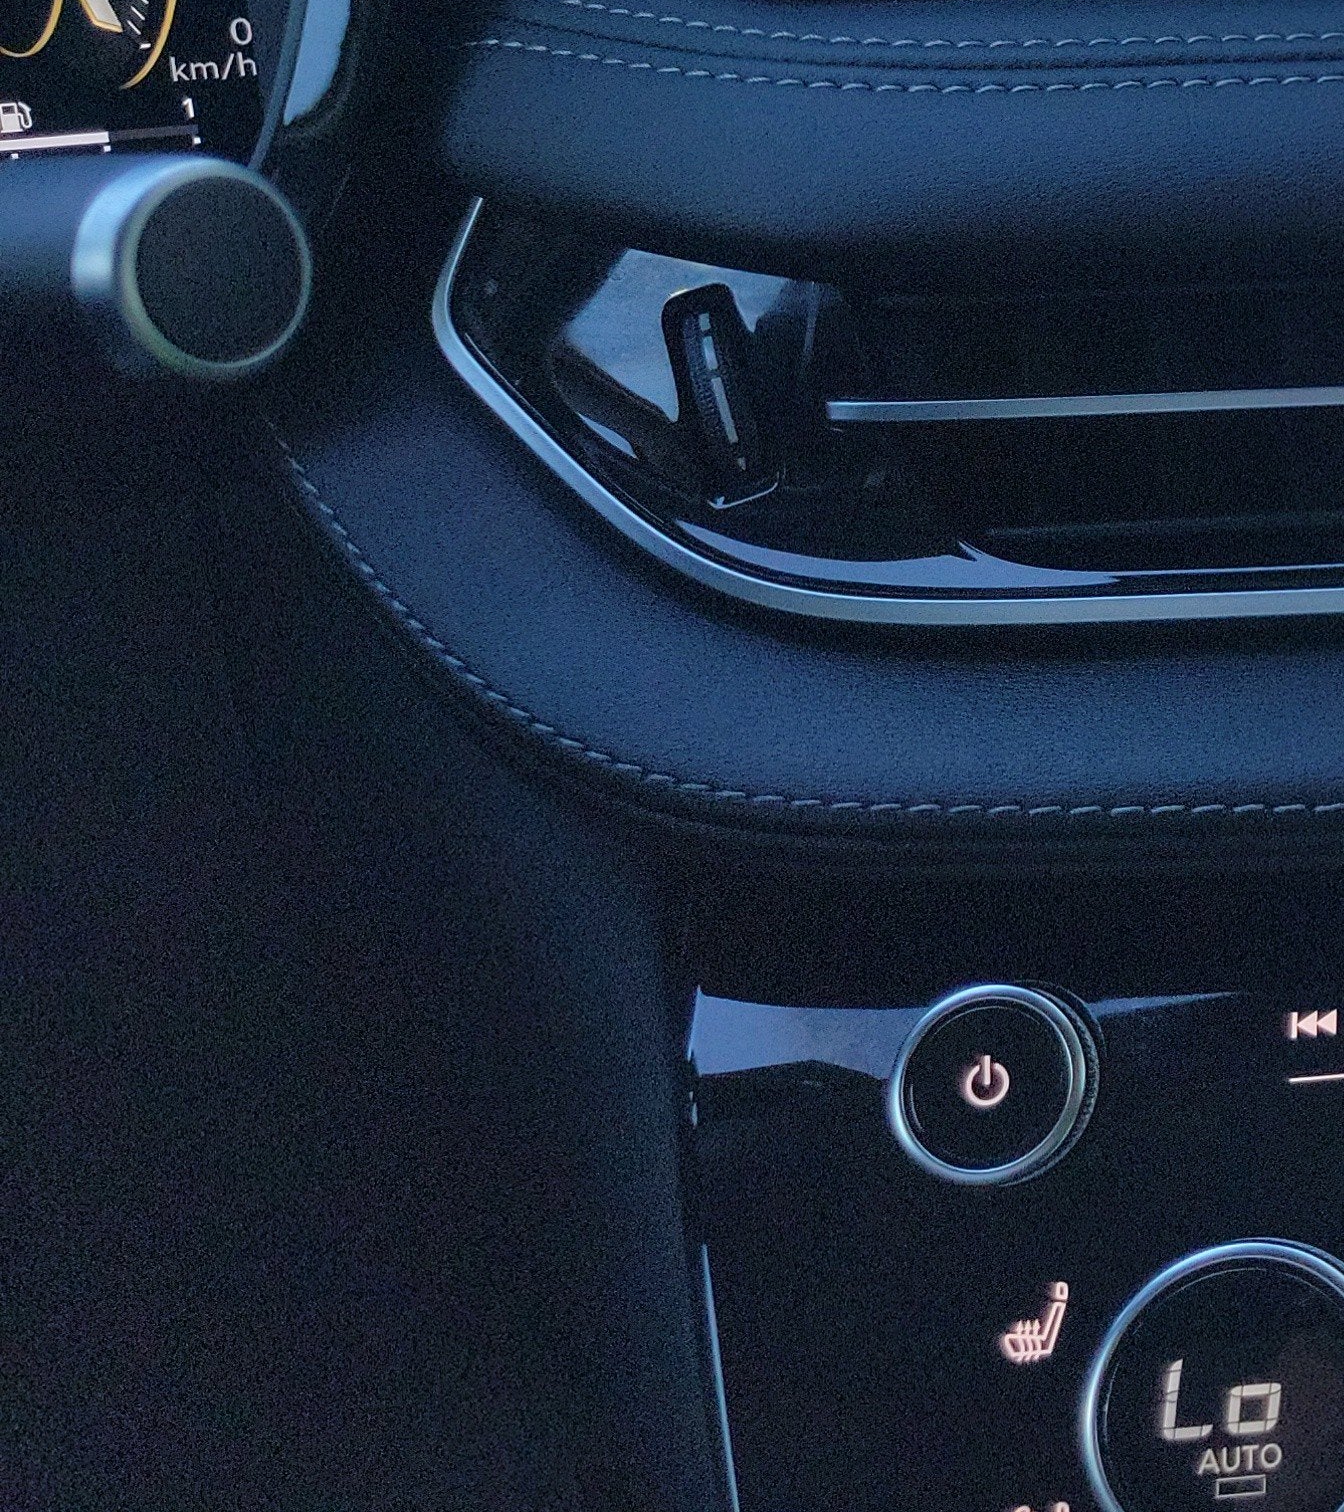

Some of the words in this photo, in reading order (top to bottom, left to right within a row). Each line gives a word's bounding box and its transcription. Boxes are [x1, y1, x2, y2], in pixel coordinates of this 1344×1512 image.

[230, 17, 252, 45] 0
[170, 51, 257, 82] km/h
[182, 98, 194, 118] 1
[1196, 1443, 1282, 1475] AUTO
